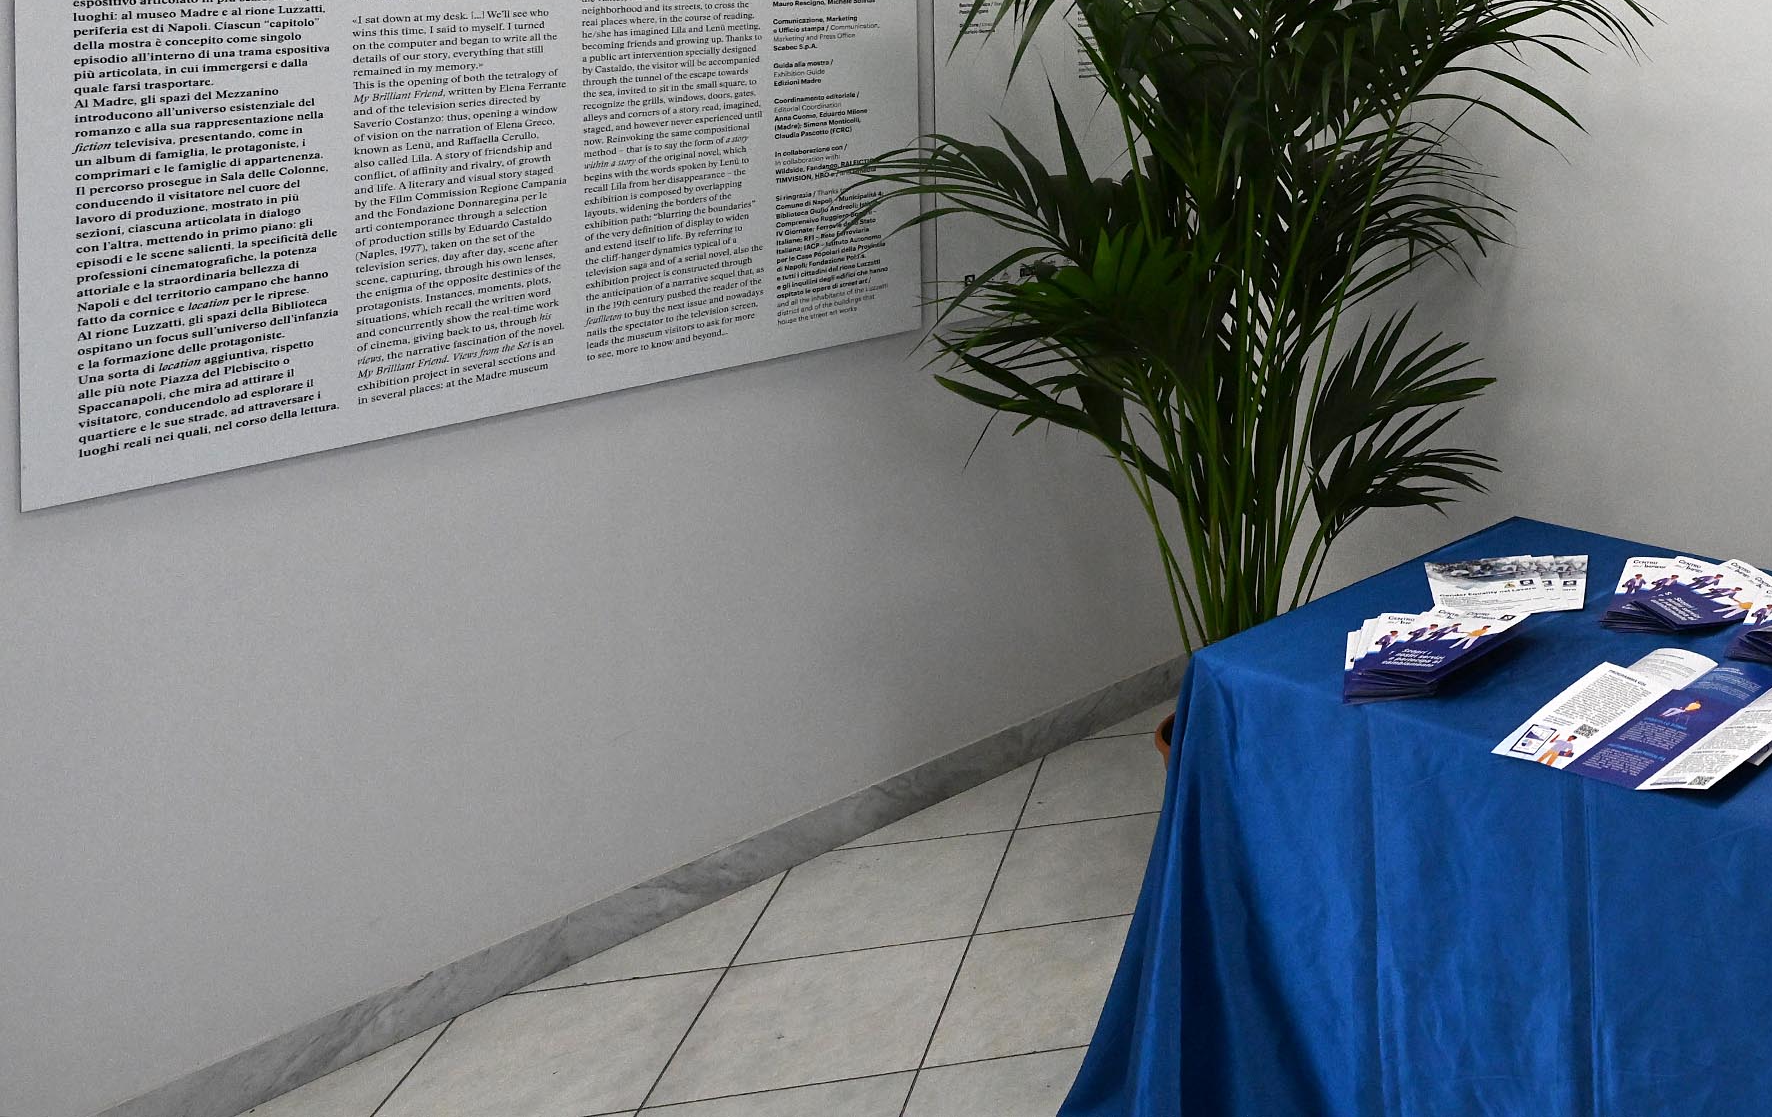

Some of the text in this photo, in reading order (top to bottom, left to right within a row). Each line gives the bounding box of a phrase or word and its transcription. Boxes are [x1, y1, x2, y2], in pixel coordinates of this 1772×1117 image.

[352, 16, 362, 24] «I
[365, 16, 379, 24] sat
[382, 15, 411, 23] down
[443, 12, 468, 20] desk.
[487, 10, 510, 18] We'll
